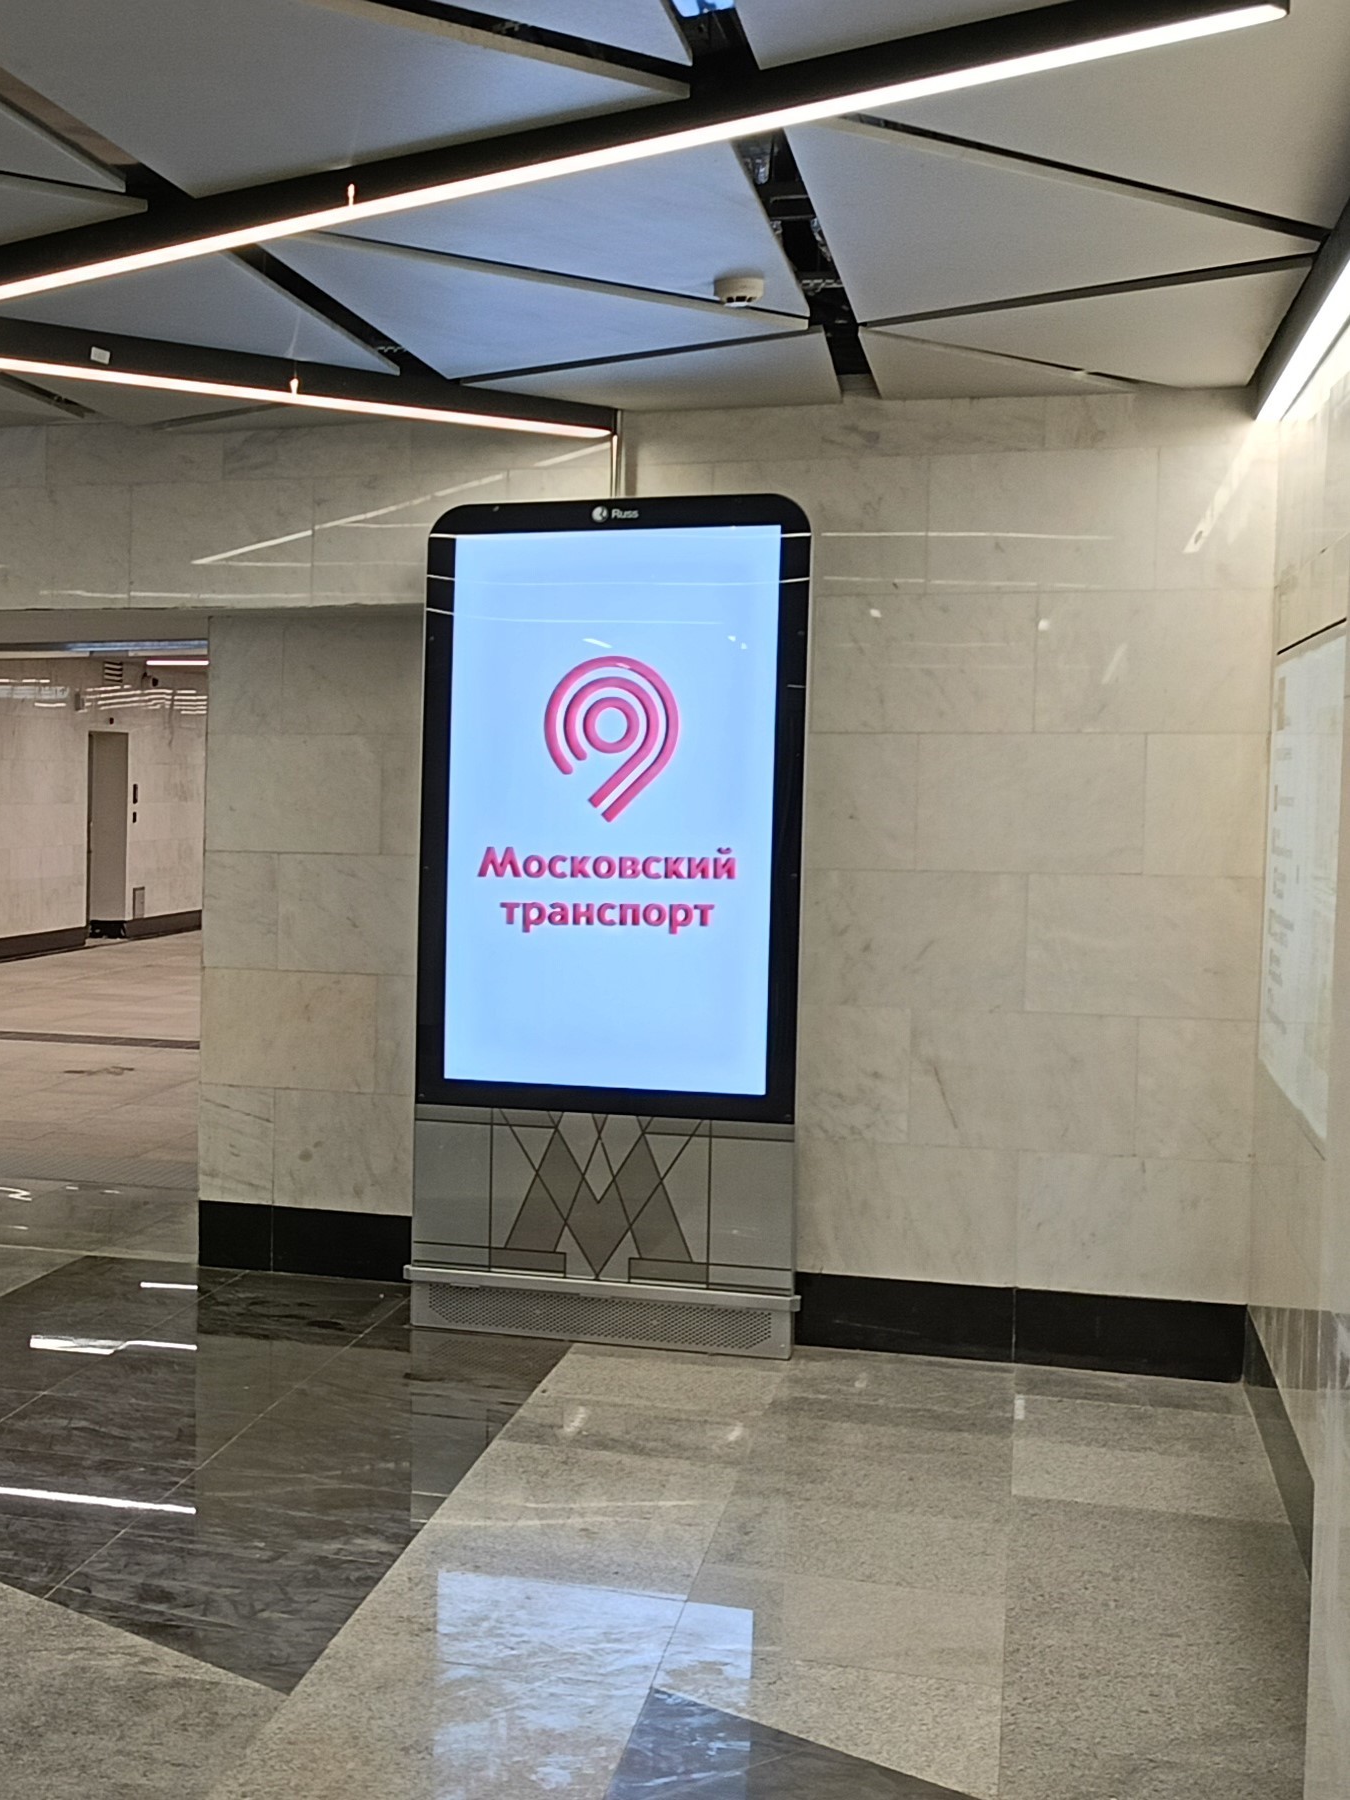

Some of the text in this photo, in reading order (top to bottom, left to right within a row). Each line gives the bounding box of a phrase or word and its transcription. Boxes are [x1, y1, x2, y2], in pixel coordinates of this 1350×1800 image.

[611, 508, 639, 519] Russ
[477, 846, 736, 880] Московский
[500, 902, 715, 935] транспорт
